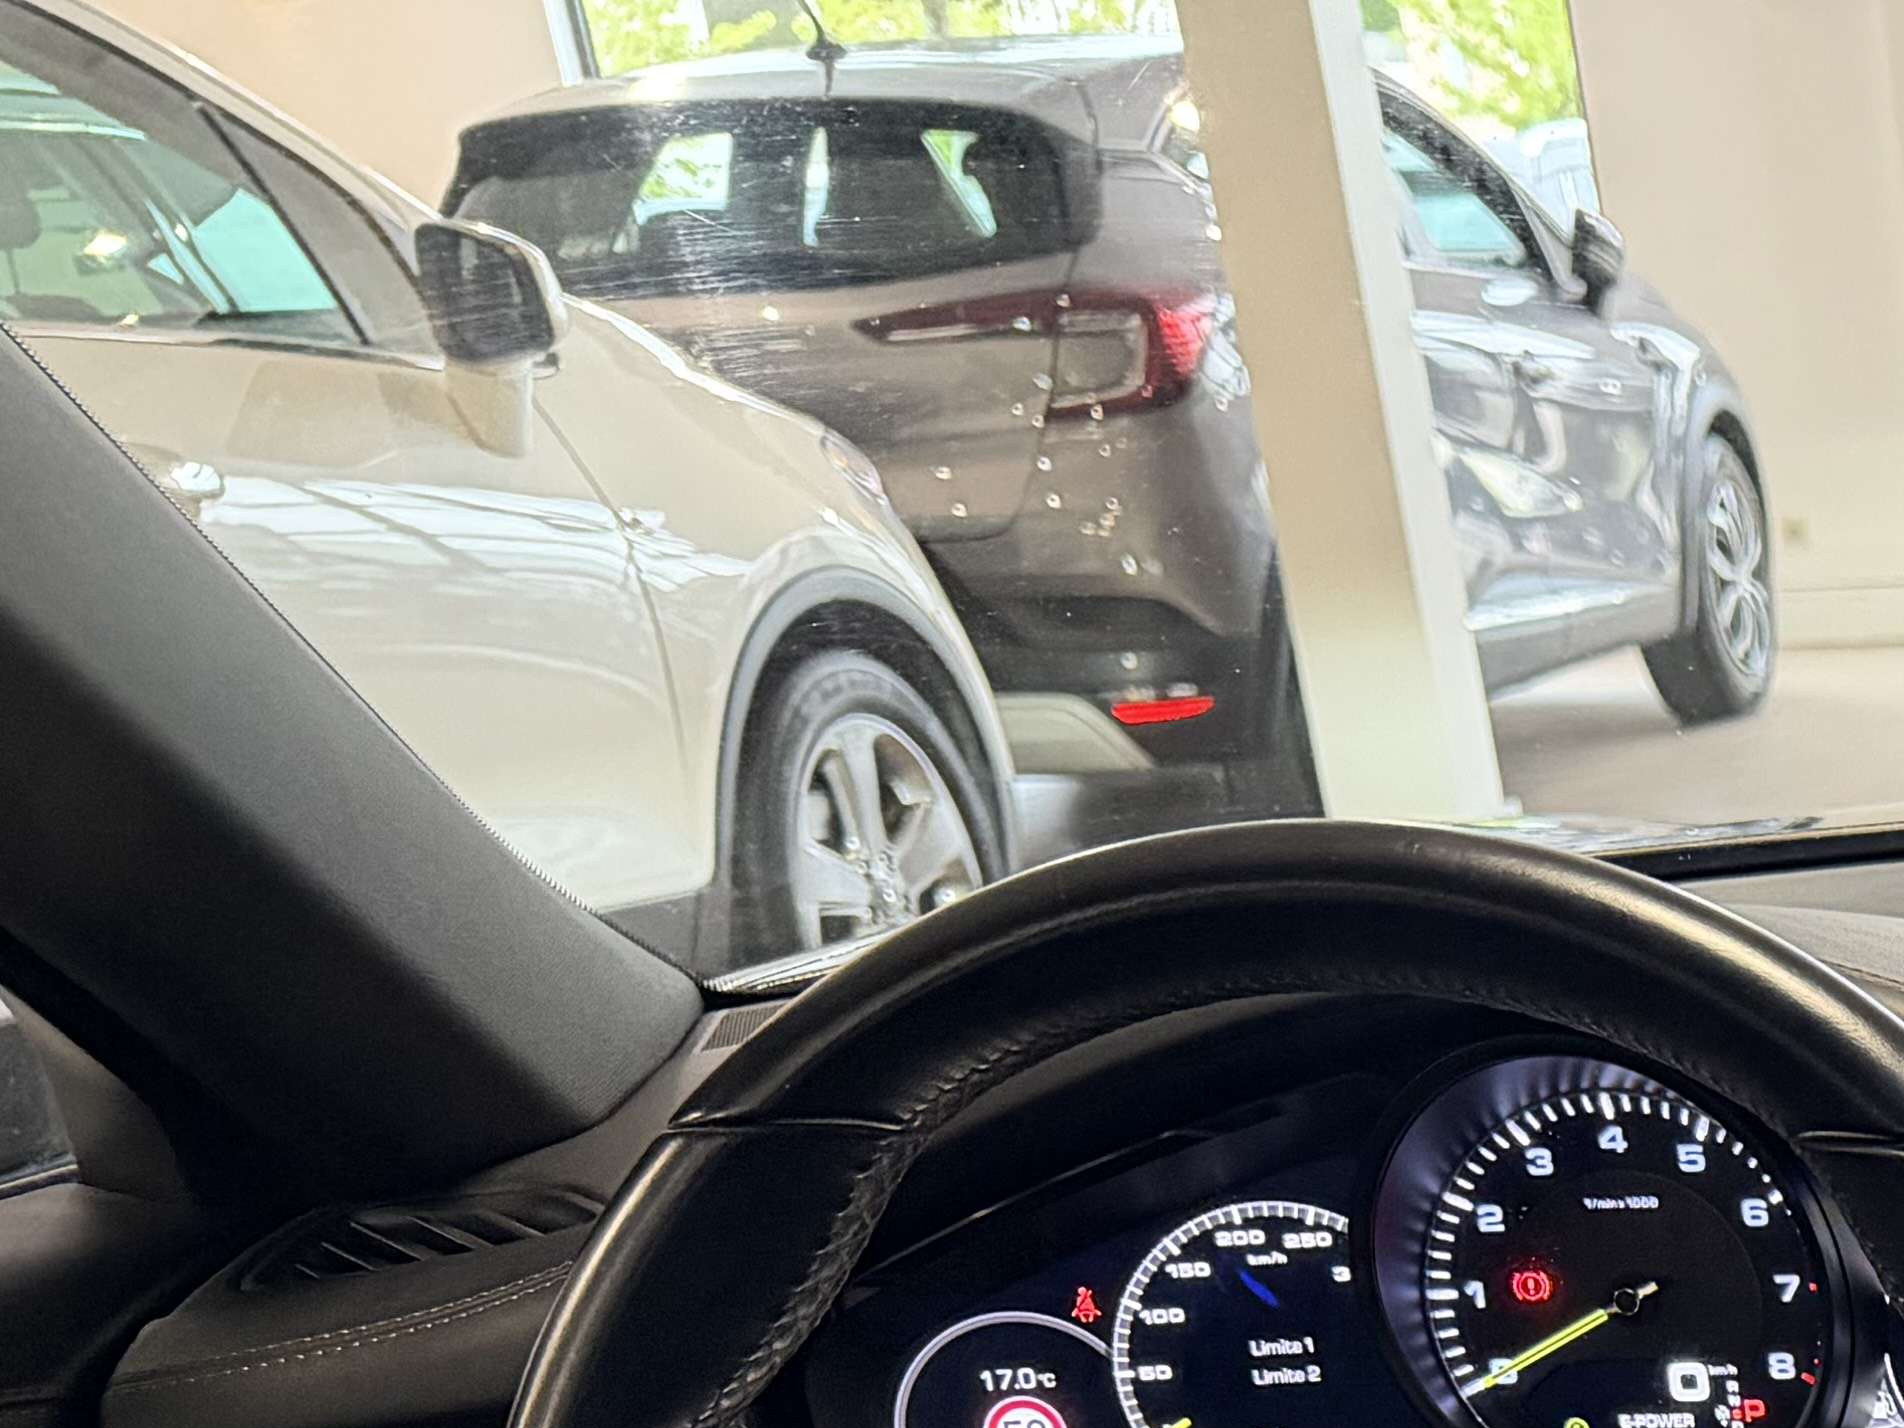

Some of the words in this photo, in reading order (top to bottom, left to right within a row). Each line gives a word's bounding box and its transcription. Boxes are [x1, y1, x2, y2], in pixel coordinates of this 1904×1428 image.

[1598, 1125, 1629, 1154] 4
[1523, 1146, 1555, 1177] 3
[1676, 1143, 1706, 1173] 5
[1475, 1203, 1506, 1233] 2
[1740, 1198, 1769, 1228] 6
[1213, 1229, 1266, 1248] 200
[1282, 1231, 1333, 1249] 250
[1164, 1261, 1211, 1279] 150
[1245, 1250, 1289, 1266] km/h
[1462, 1280, 1487, 1310] 1
[1773, 1273, 1801, 1303] 7
[1138, 1307, 1186, 1325] 100
[1249, 1338, 1303, 1358] Limite
[1303, 1336, 1315, 1354] 1
[1137, 1364, 1173, 1381] 50
[1251, 1368, 1305, 1386] Limite
[1306, 1364, 1322, 1383] 2
[1767, 1352, 1796, 1380] 8
[1666, 1361, 1711, 1403] 0
